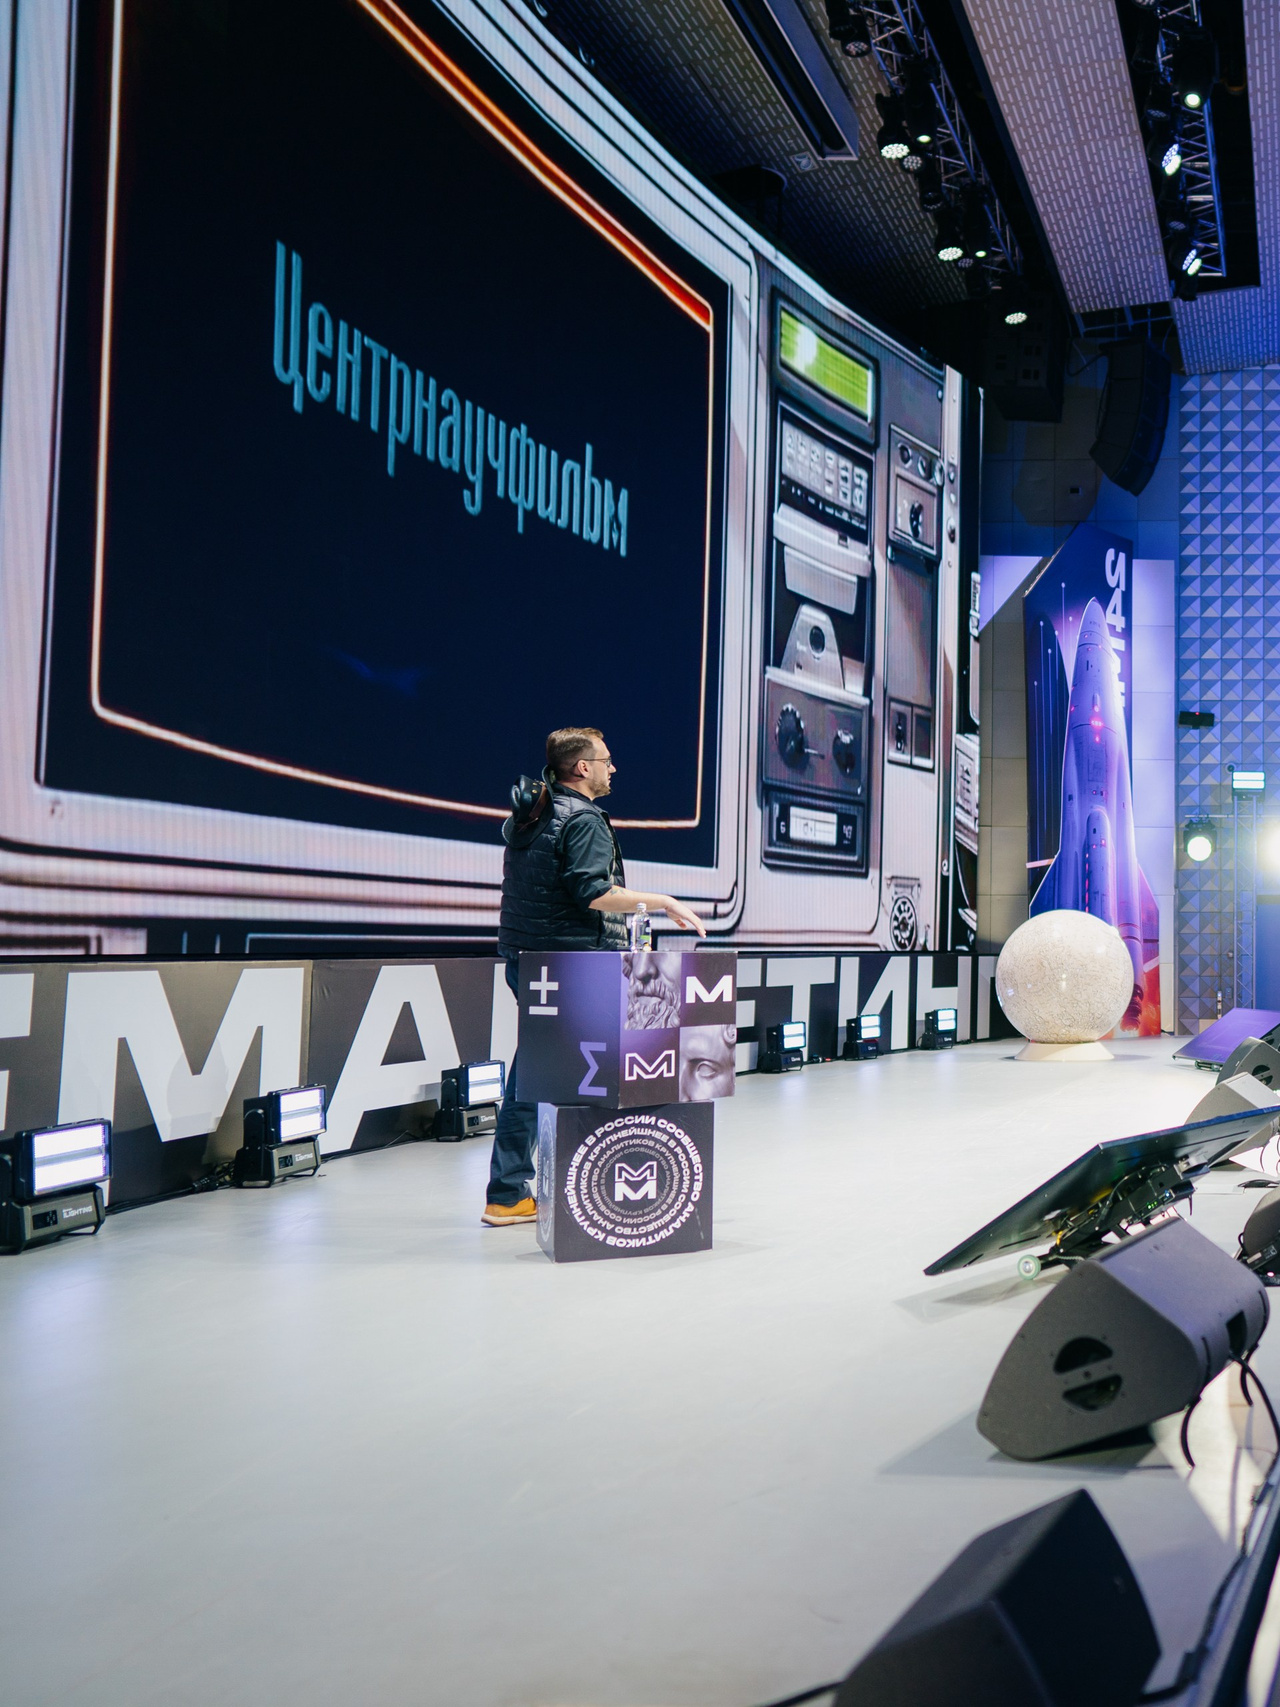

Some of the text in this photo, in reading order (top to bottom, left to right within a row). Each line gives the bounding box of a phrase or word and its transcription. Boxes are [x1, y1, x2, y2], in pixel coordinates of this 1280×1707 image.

[272, 240, 629, 557] Центрнаучфильм
[685, 974, 733, 1004] M
[564, 1115, 704, 1249] КРУПНЕЙШНЕЕ В РОССИИ СООБЩЕСТВО АНАЛИТИКОВ
[580, 1127, 690, 1236] КРУПНЕЙШНЕЕ В РОССИИ СООБЩЕСТВО АНАЛИТИКОВ
[597, 1139, 655, 1167] АНАЛИТИКОВ
[655, 1143, 680, 1205] КРУПНЕЙШНЕЕ
[592, 1168, 622, 1222] СООБЩЕСТВО
[623, 1209, 662, 1224] РОССИИ
